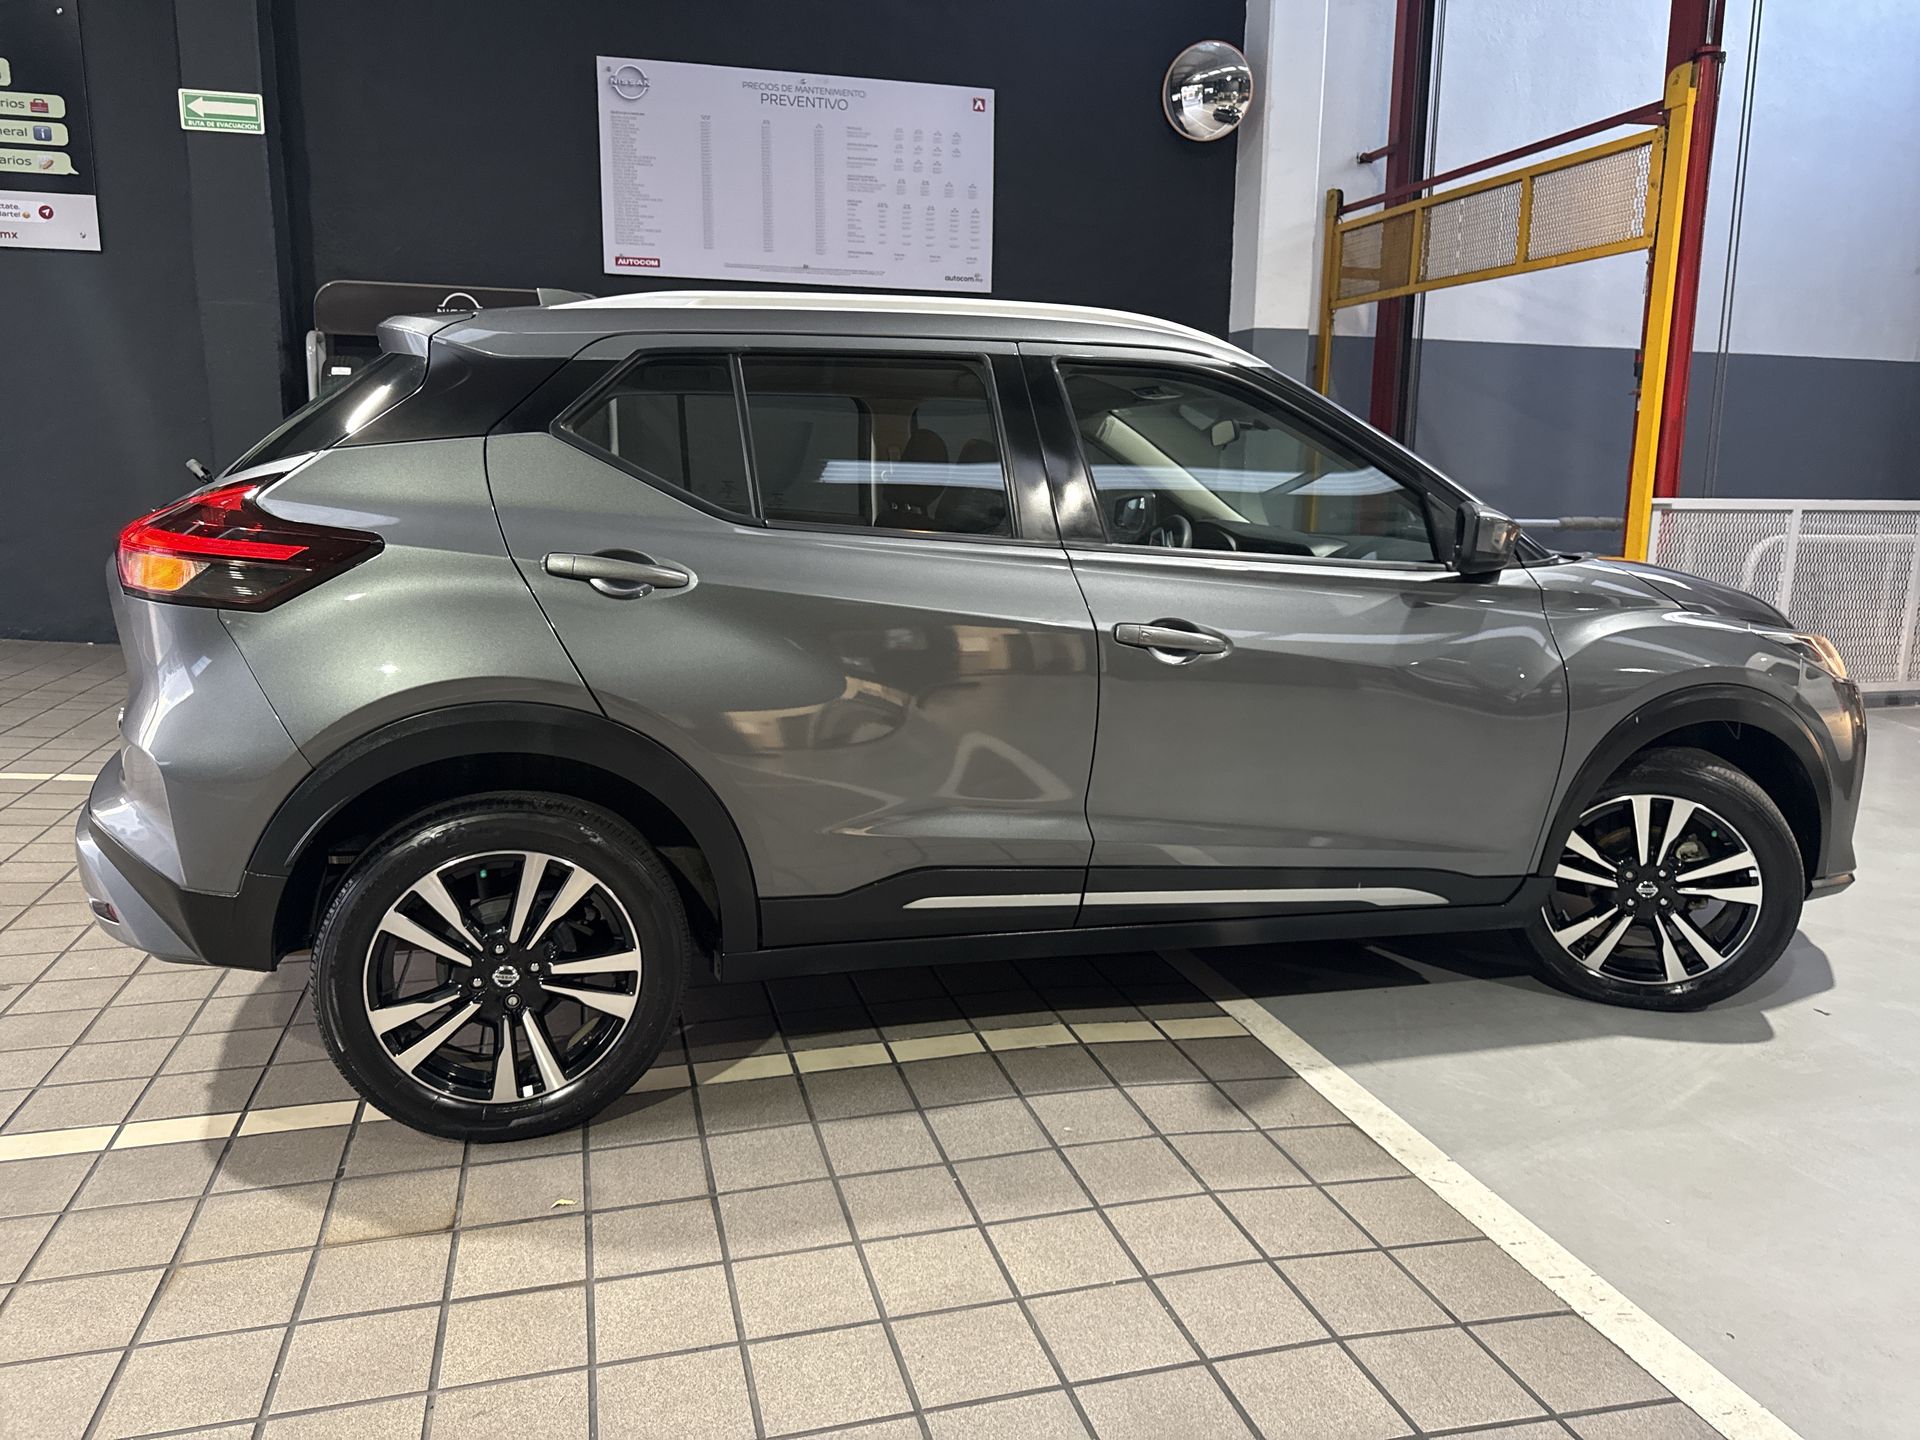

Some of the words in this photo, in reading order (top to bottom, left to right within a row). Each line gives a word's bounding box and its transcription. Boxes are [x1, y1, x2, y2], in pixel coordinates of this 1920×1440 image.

[609, 76, 650, 87] NISSAN
[742, 81, 779, 92] PRECIOS
[781, 84, 793, 93] DE
[795, 85, 867, 99] MANTENIMIENTO
[760, 93, 848, 111] PREVENTIVO
[617, 258, 659, 266] AUTOCOM
